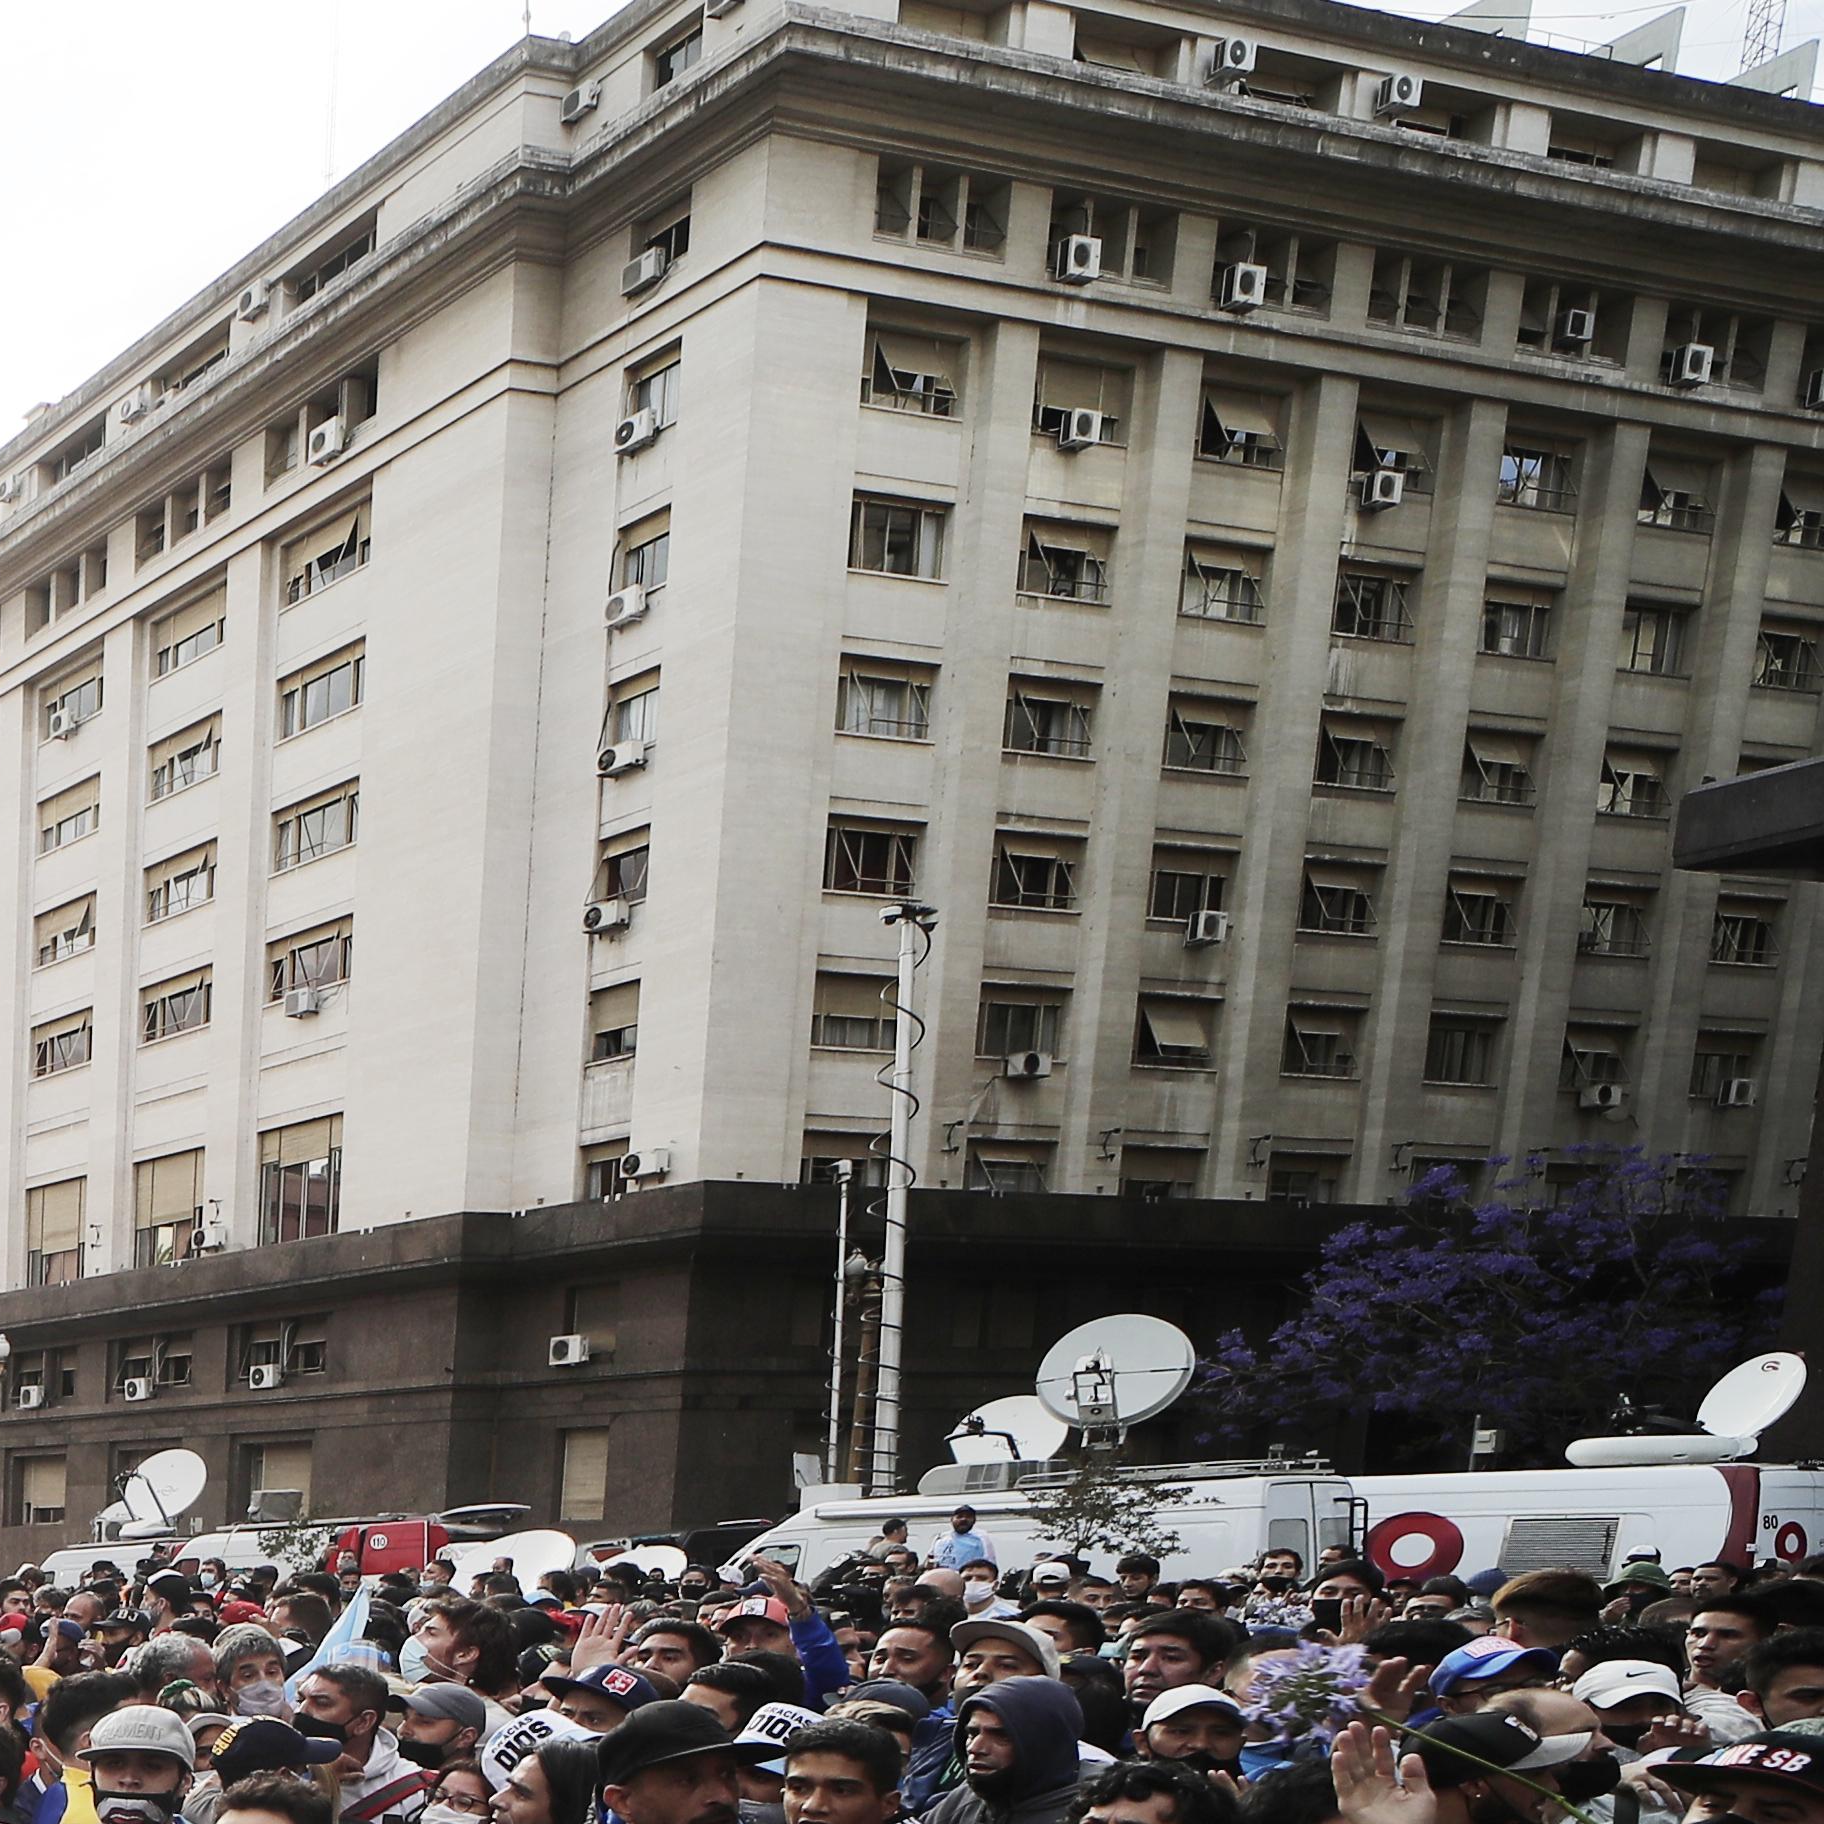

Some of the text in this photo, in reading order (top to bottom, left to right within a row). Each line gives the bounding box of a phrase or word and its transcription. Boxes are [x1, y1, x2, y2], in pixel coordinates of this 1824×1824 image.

[1762, 1515, 1778, 1530] 80
[372, 1536, 387, 1548] 110
[493, 1720, 553, 1773] DIOS
[1762, 1747, 1813, 1772] SB
